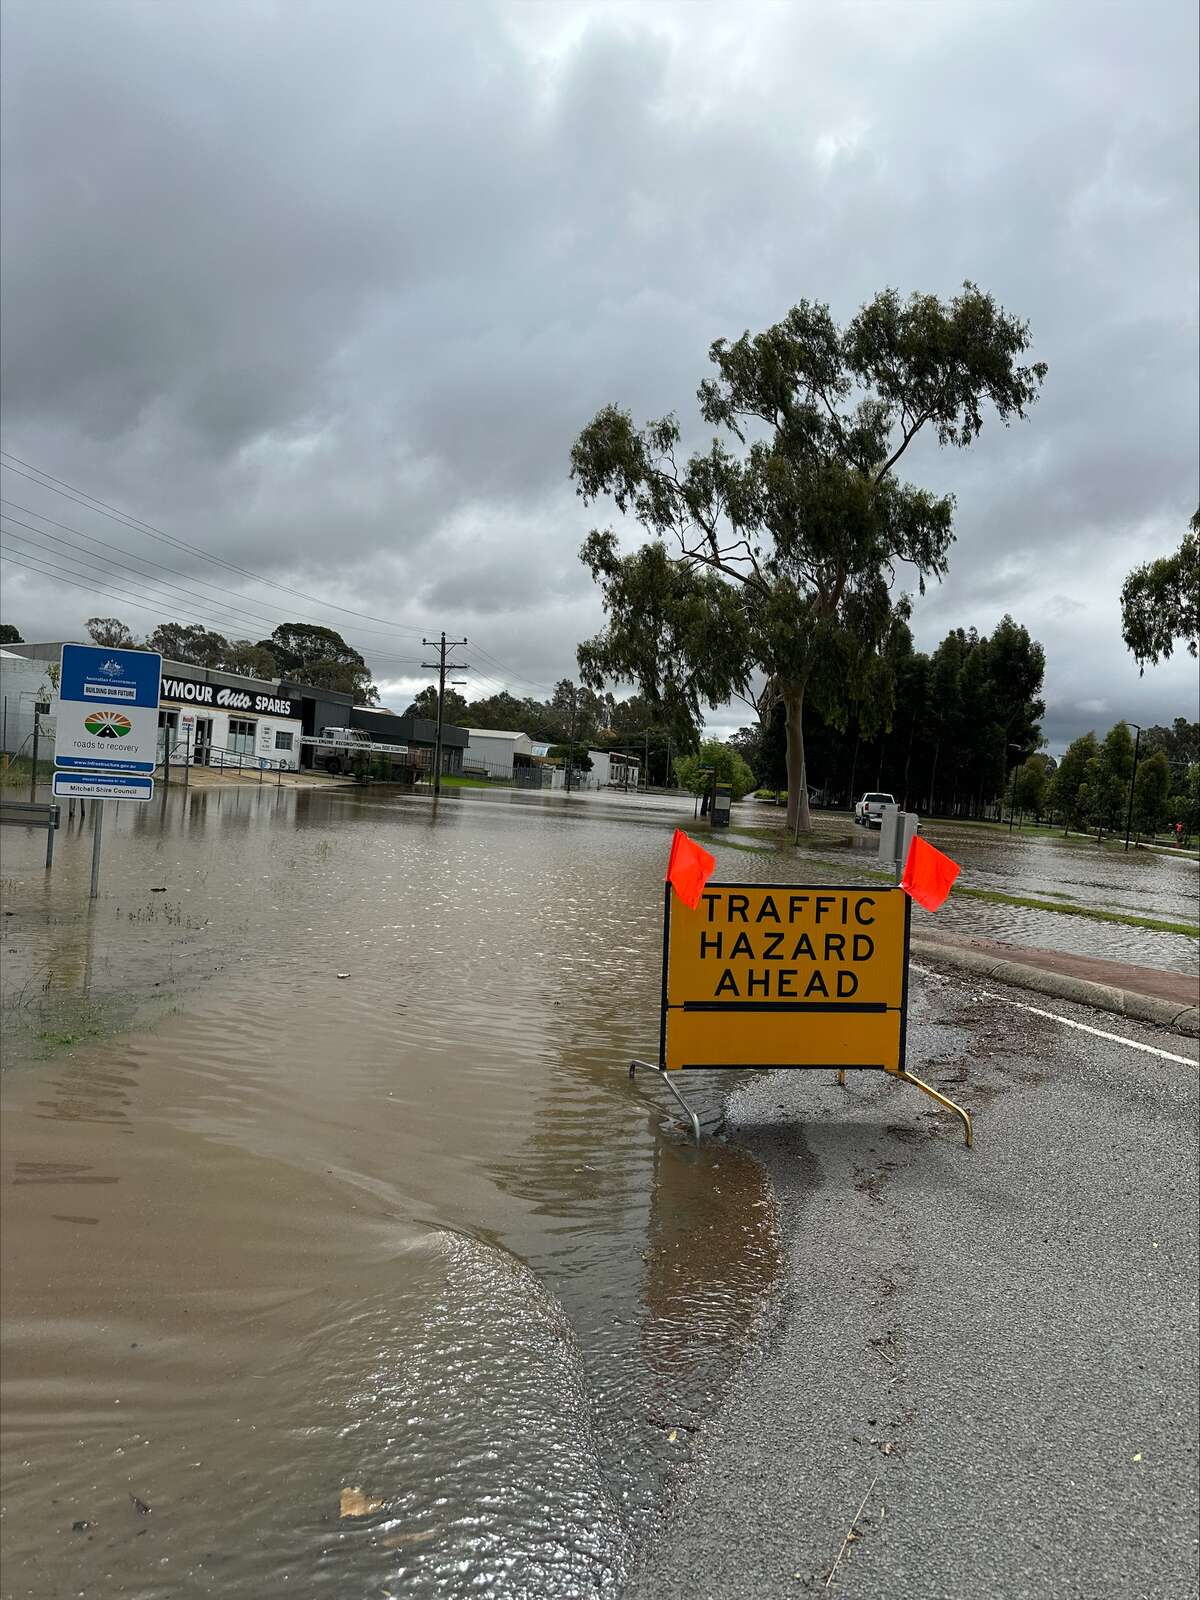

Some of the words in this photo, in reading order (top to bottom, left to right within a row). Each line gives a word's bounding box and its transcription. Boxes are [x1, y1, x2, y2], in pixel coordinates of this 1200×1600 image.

[85, 686, 107, 696] BUILDING
[107, 688, 118, 696] OUR
[117, 689, 135, 698] FUTURE
[160, 679, 213, 702] YMOUR
[255, 696, 291, 715] SPARES
[73, 740, 96, 749] roads
[97, 741, 105, 750] to
[107, 744, 139, 753] recovery
[701, 894, 876, 926] TRAFFIC
[700, 931, 875, 961] HAZARD
[714, 968, 859, 998] AHEAD
